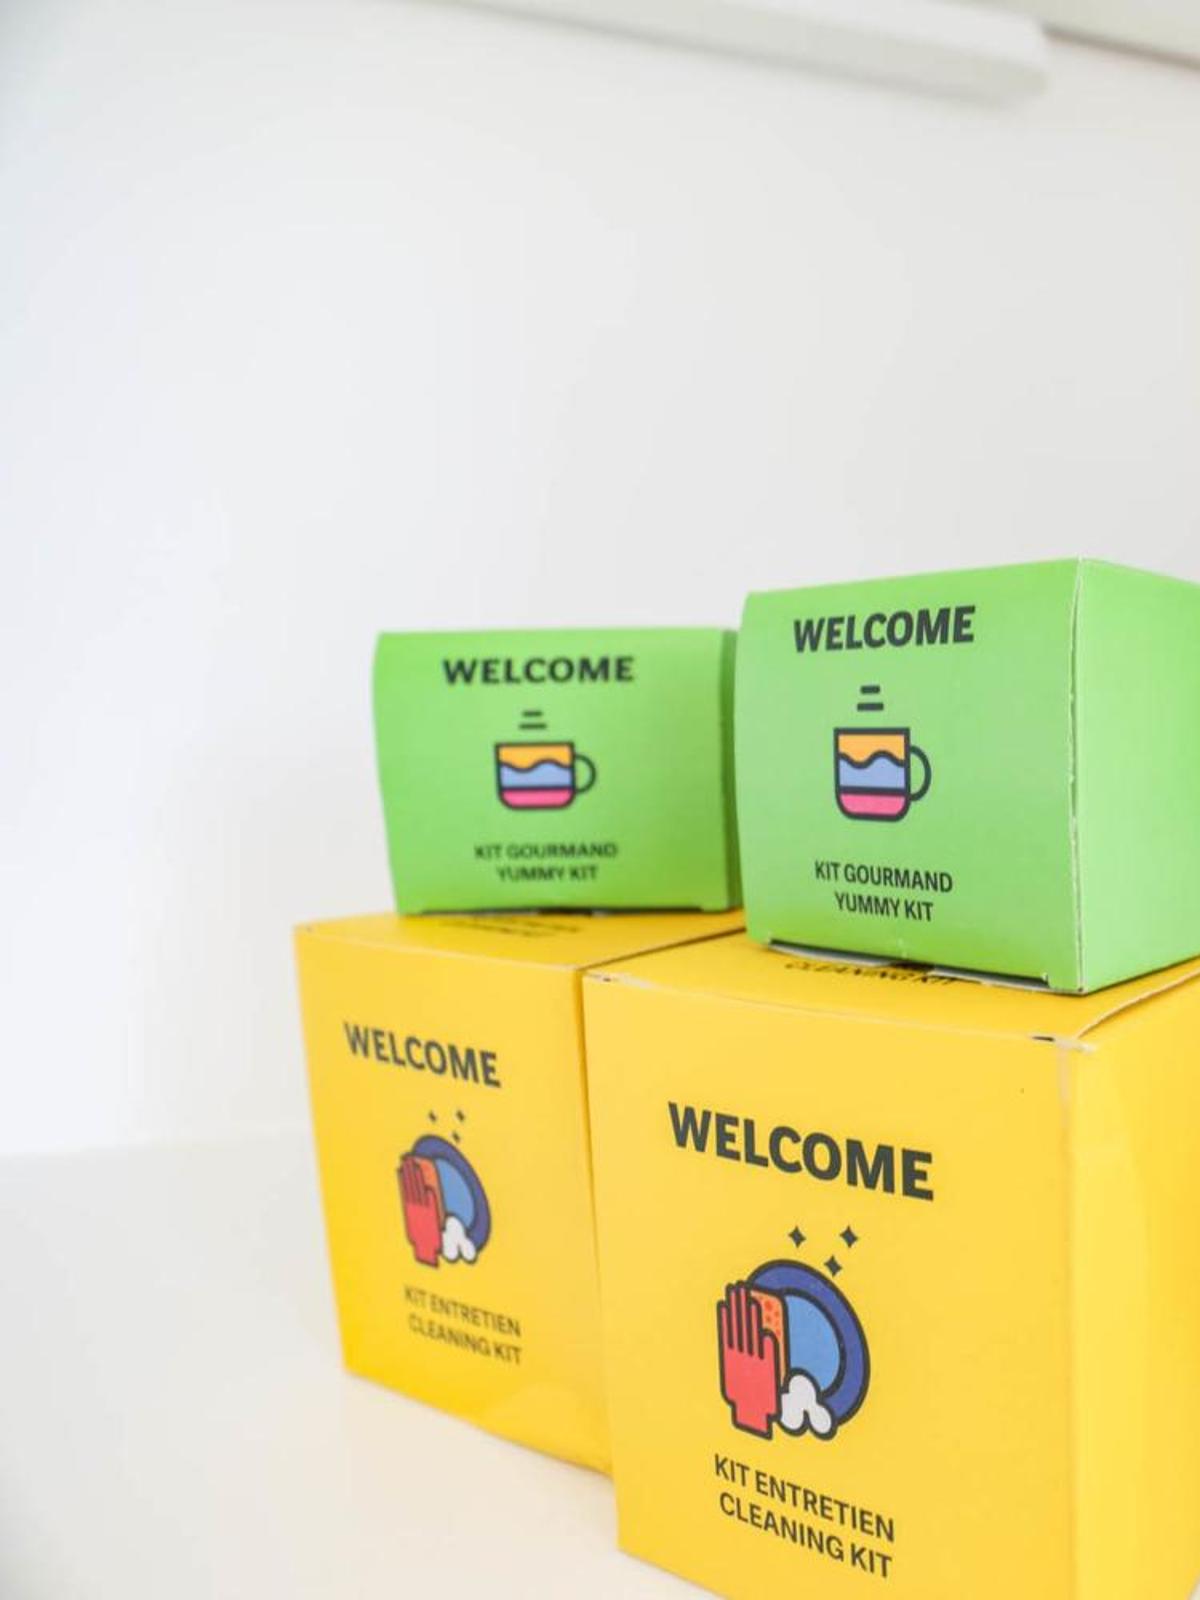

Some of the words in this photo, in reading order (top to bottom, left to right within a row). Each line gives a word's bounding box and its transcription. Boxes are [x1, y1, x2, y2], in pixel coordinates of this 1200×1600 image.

[794, 604, 976, 653] WELCOME
[442, 656, 635, 685] WELCOME
[474, 844, 502, 860] KIT
[506, 842, 620, 860] GOURMAND
[497, 865, 565, 882] YUMMY
[569, 864, 599, 881] KIT
[815, 860, 841, 881] KIT
[843, 863, 953, 893] GOURMAND
[835, 891, 900, 918] YUMMY
[904, 898, 934, 921] KIT
[343, 1023, 502, 1089] WELCOME
[668, 1101, 934, 1201] WELCOME
[404, 1285, 427, 1308] KIT
[429, 1293, 522, 1339] ENTRETIEN
[408, 1312, 492, 1357] CLEANING
[494, 1341, 522, 1365] KIT
[715, 1453, 750, 1487] KIT
[755, 1469, 895, 1543] ENTRETIEN
[719, 1492, 845, 1562] CLEANING
[850, 1543, 893, 1578] KIT
